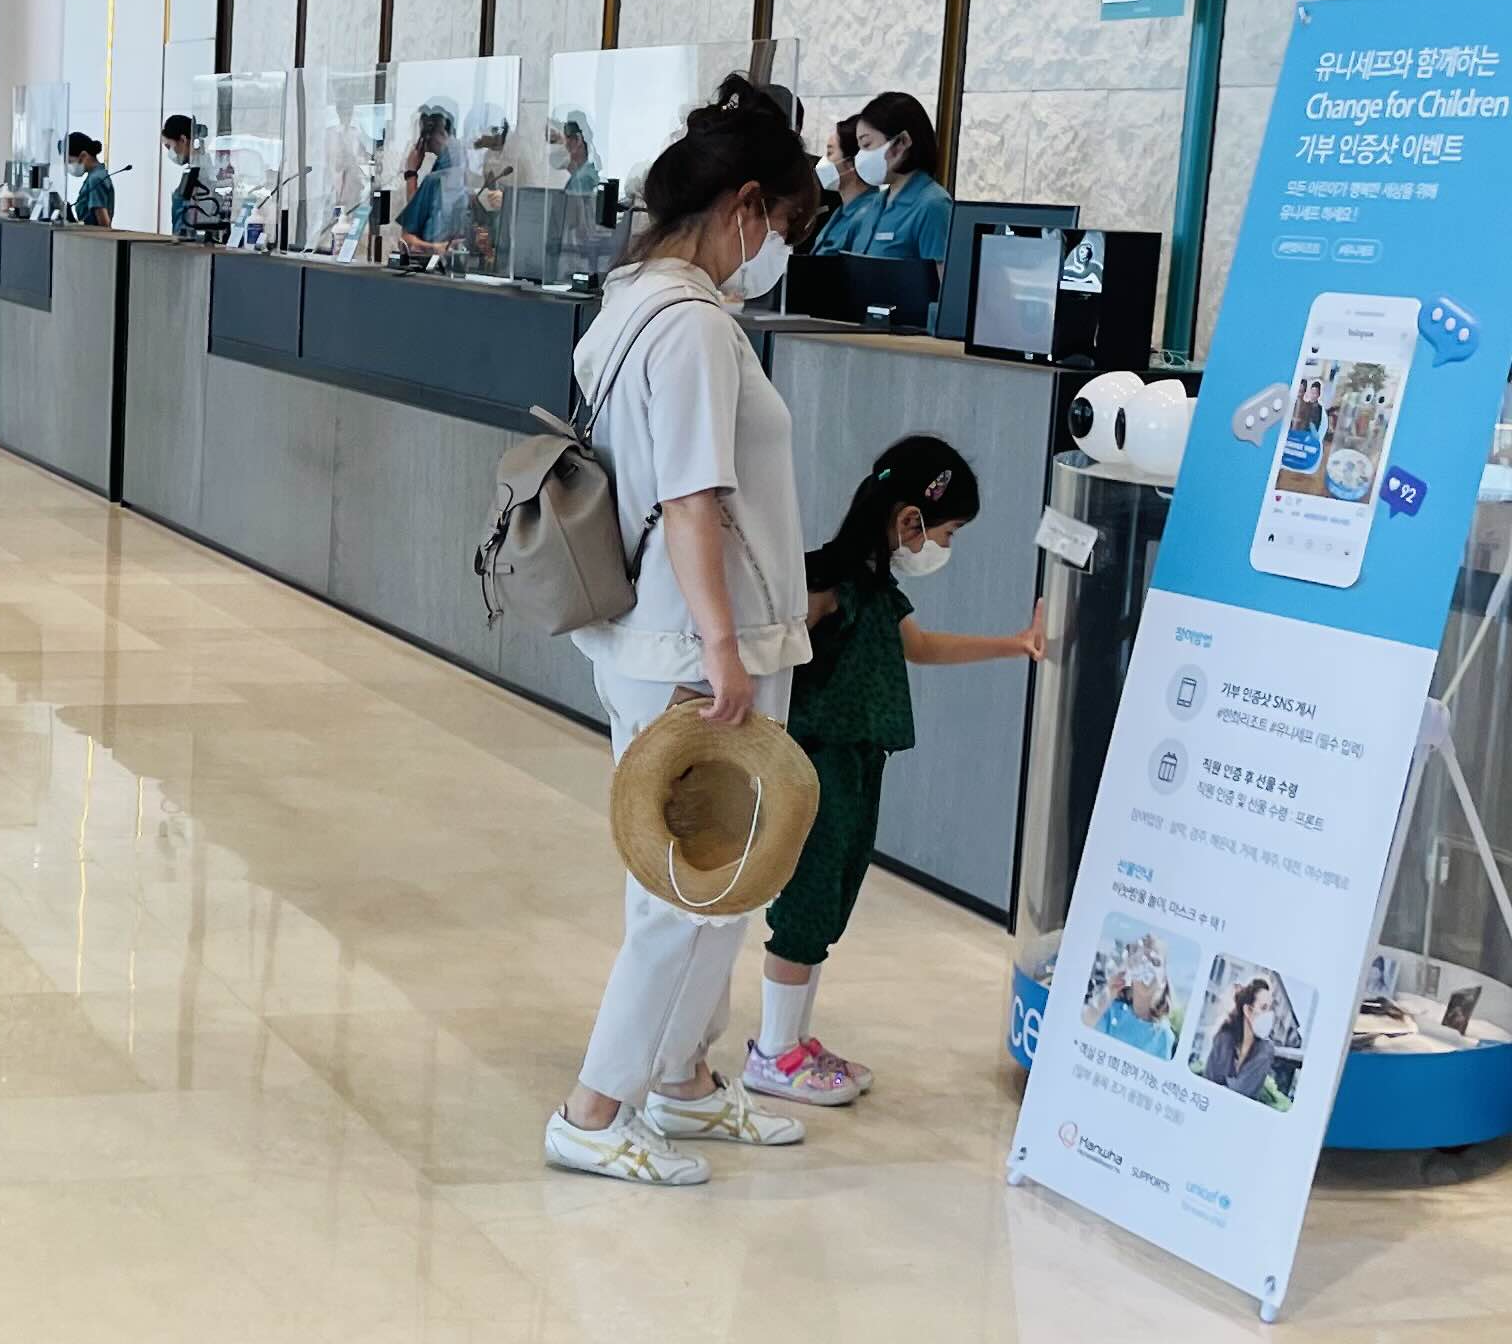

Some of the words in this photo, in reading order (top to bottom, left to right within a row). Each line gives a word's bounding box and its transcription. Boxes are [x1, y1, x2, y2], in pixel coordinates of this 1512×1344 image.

[1315, 50, 1413, 81] 유니세프와
[1417, 45, 1500, 78] 함께하는
[1306, 93, 1385, 128] Change
[1385, 91, 1416, 119] for
[1418, 88, 1509, 119] Children
[1295, 135, 1338, 164] 기부
[1339, 134, 1398, 165] 인증샷
[1401, 134, 1463, 165] 이벤트
[1400, 483, 1418, 504] 92
[1221, 682, 1241, 698] 기부
[1243, 687, 1272, 708] 인증샷
[1273, 696, 1295, 712] SNS
[1295, 700, 1317, 720] 게시
[1269, 719, 1314, 744] #유니세프
[1202, 757, 1222, 776] 직원
[1223, 763, 1243, 782] 인증
[1244, 770, 1255, 785] 후
[1256, 774, 1276, 793] 선물
[1278, 781, 1299, 799] 수령
[1169, 900, 1196, 920] 마스크
[1080, 1136, 1122, 1165] Hanwha
